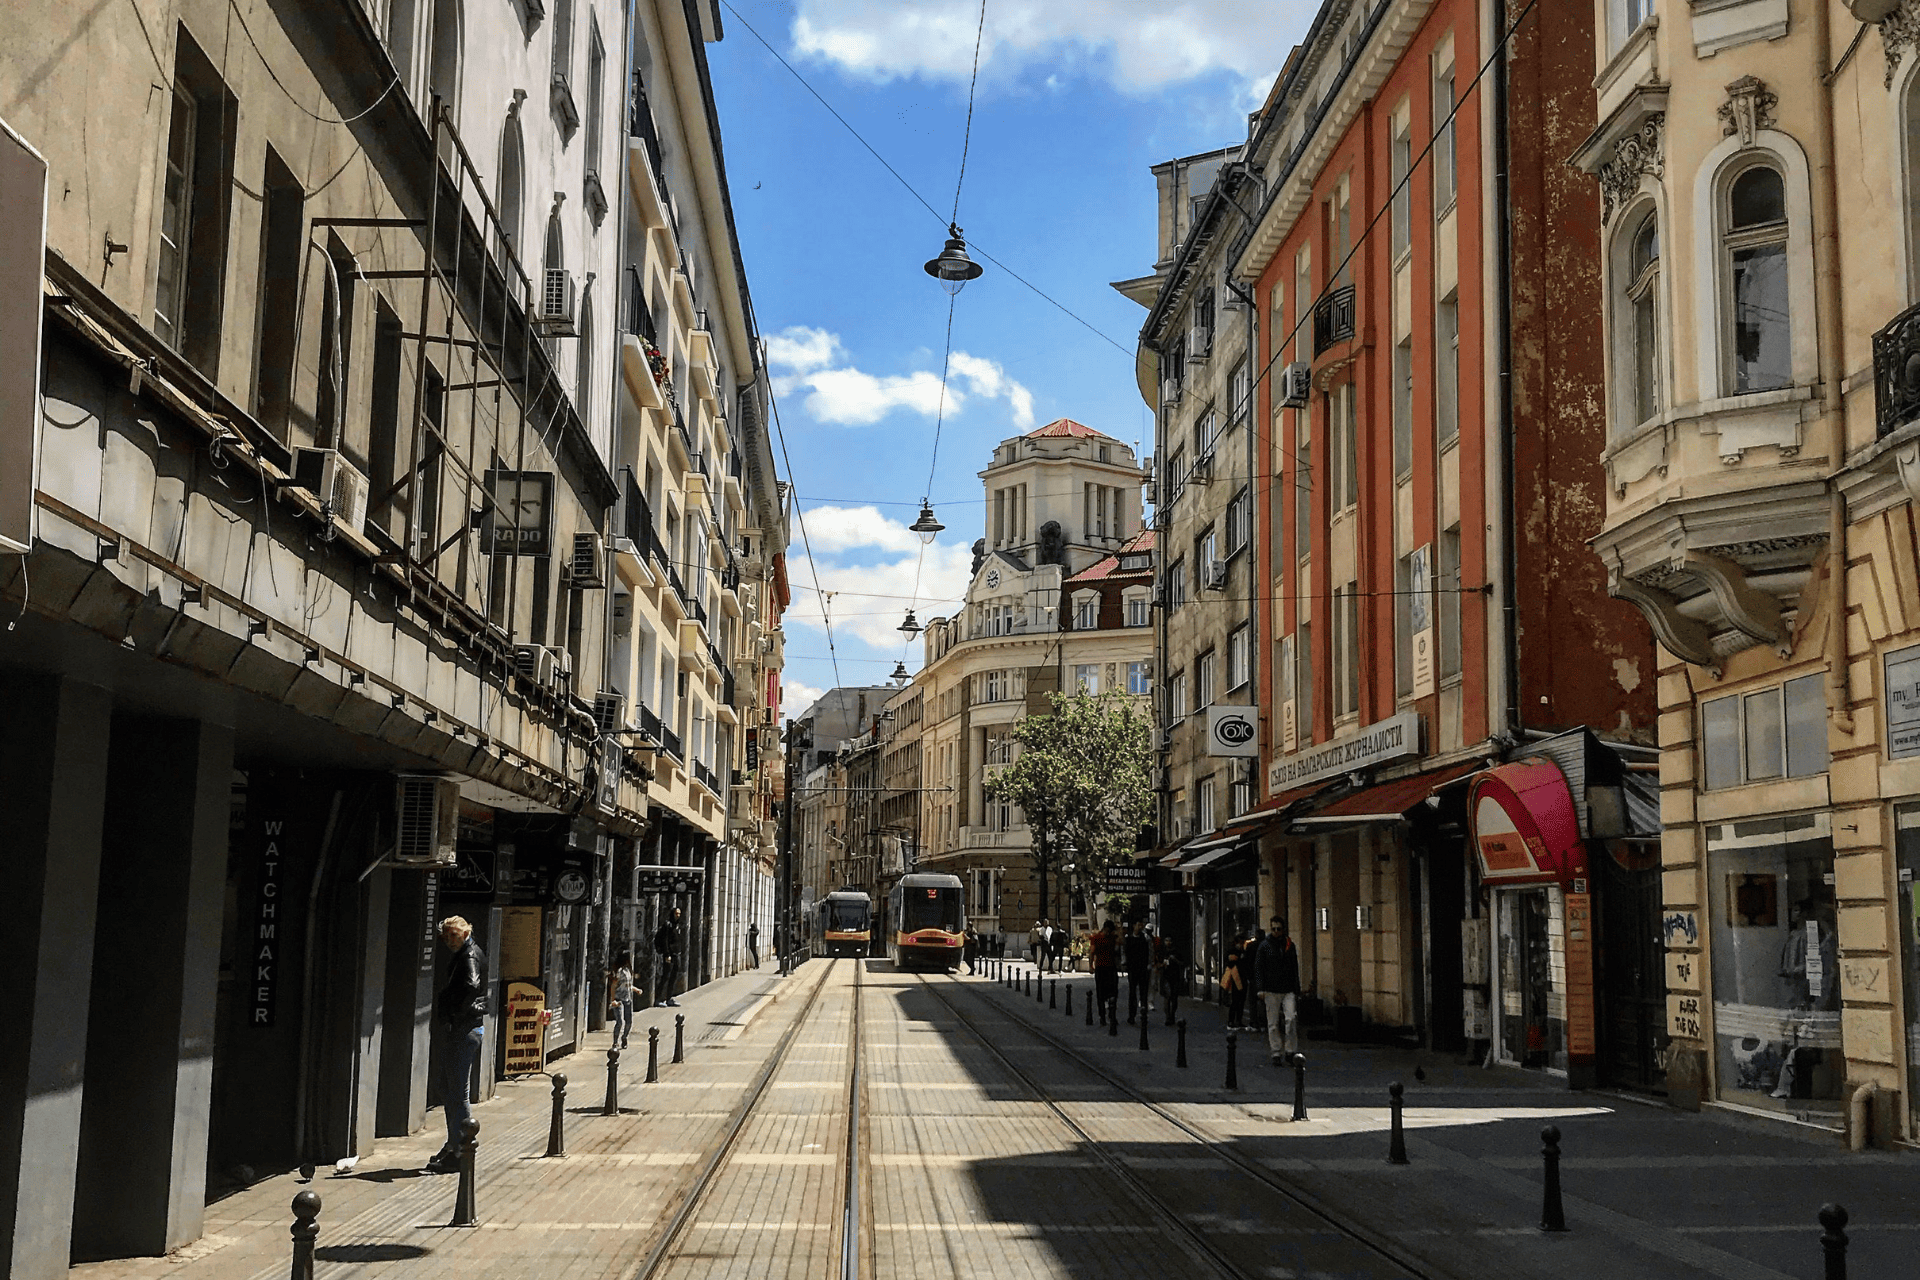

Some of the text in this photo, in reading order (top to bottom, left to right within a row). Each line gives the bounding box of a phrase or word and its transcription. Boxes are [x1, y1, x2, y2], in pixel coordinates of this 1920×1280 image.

[1287, 761, 1297, 782] НА
[1297, 745, 1344, 778] БЪЛГАРСКИТЕ
[1344, 724, 1403, 762] ЖУРНАЛИСТИ
[1108, 868, 1146, 878] ПРЕВОДИ
[254, 820, 283, 1023] WATCHMAKER
